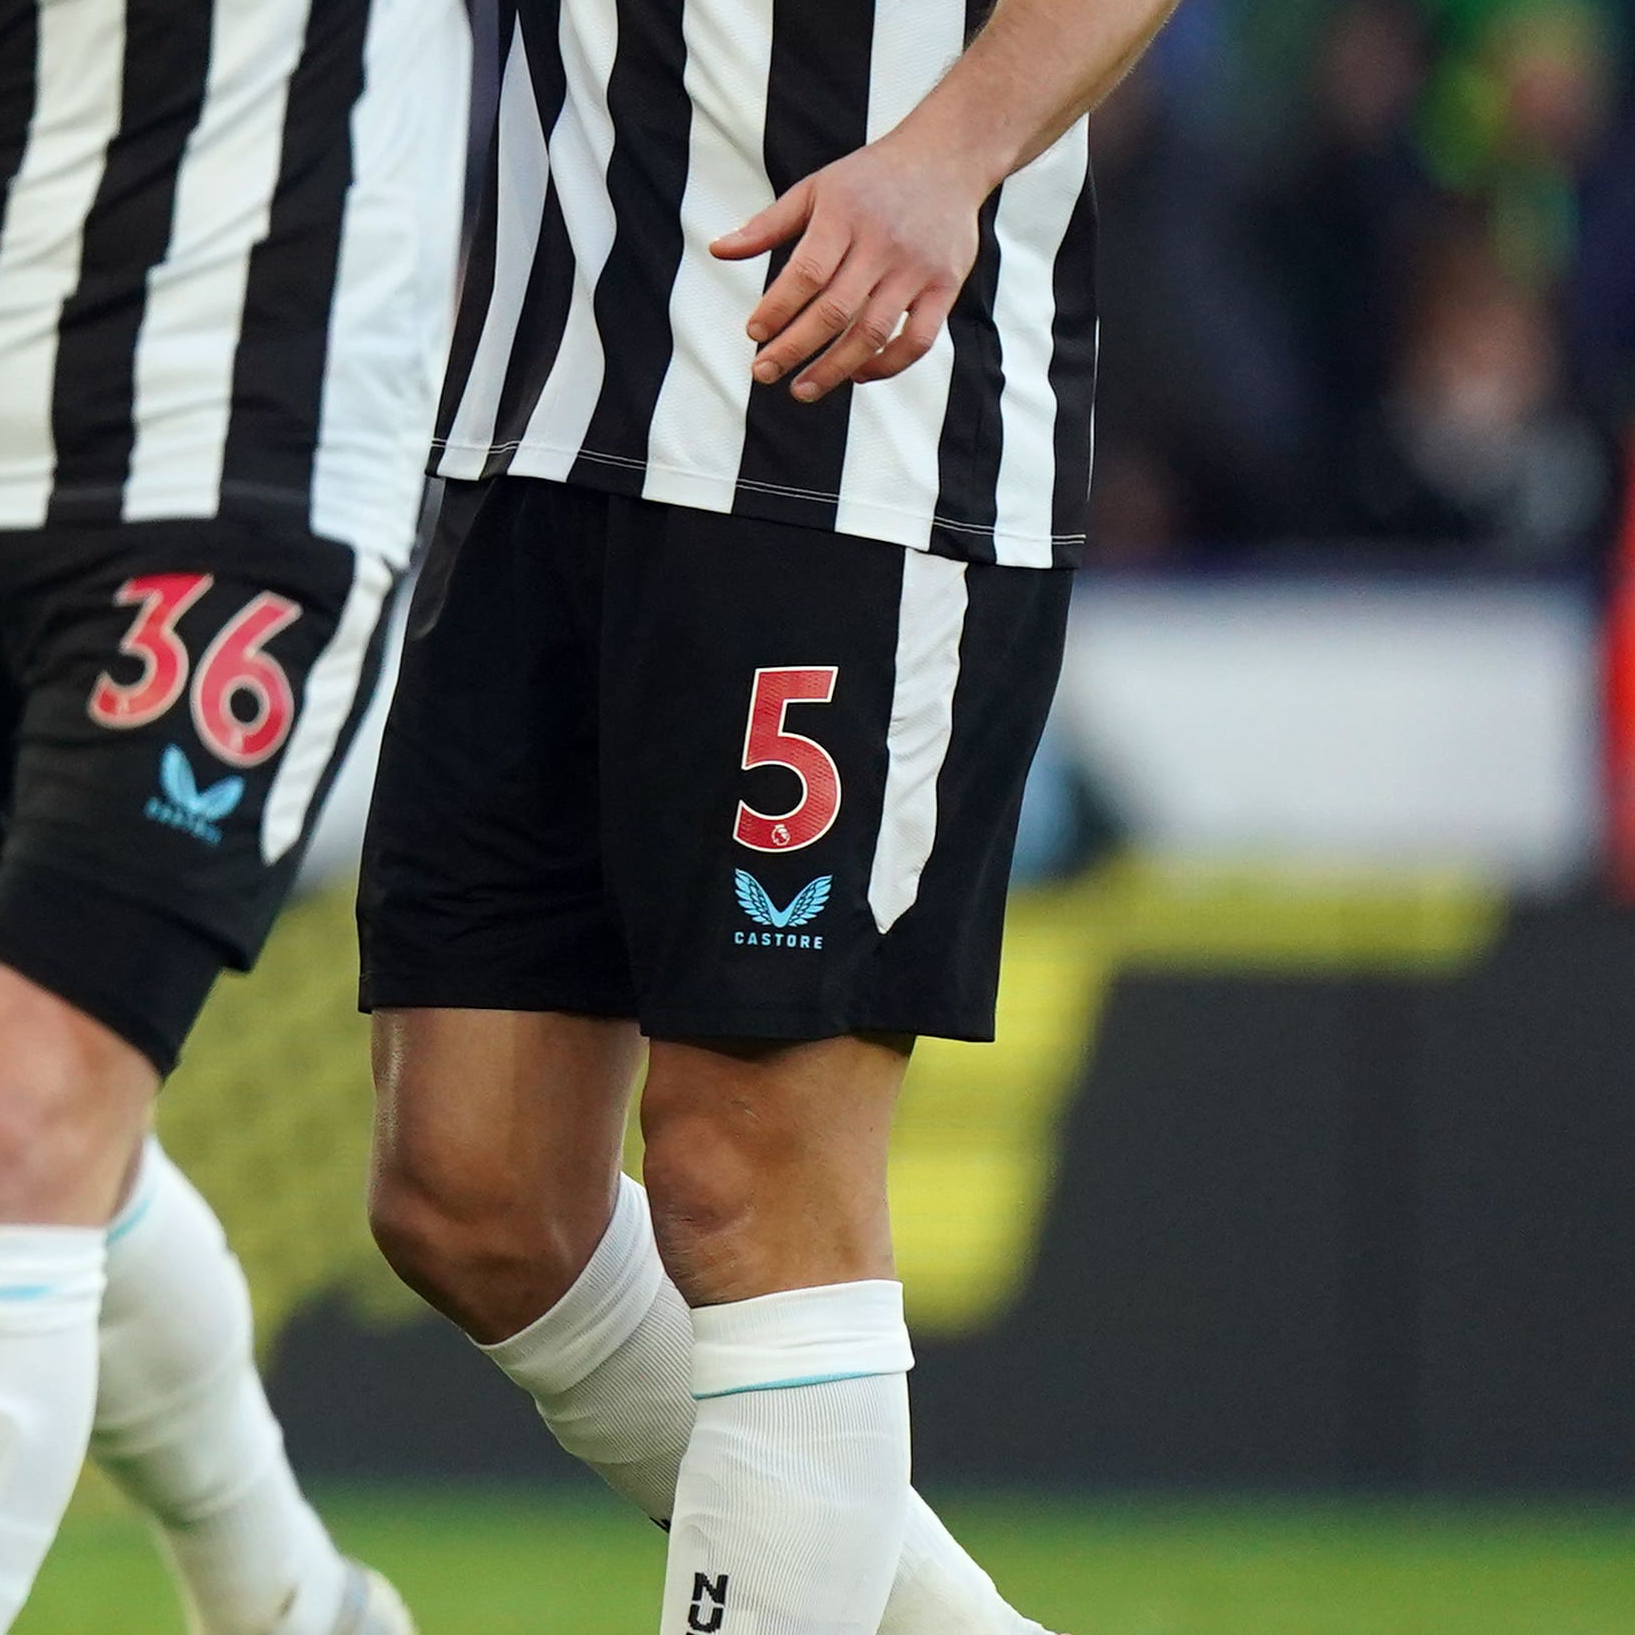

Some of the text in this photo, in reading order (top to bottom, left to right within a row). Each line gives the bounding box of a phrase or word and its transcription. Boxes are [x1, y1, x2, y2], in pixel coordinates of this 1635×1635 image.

[87, 571, 303, 769] 36
[733, 666, 842, 853] 5
[734, 930, 824, 949] CASTORE
[686, 1572, 729, 1635] NU
